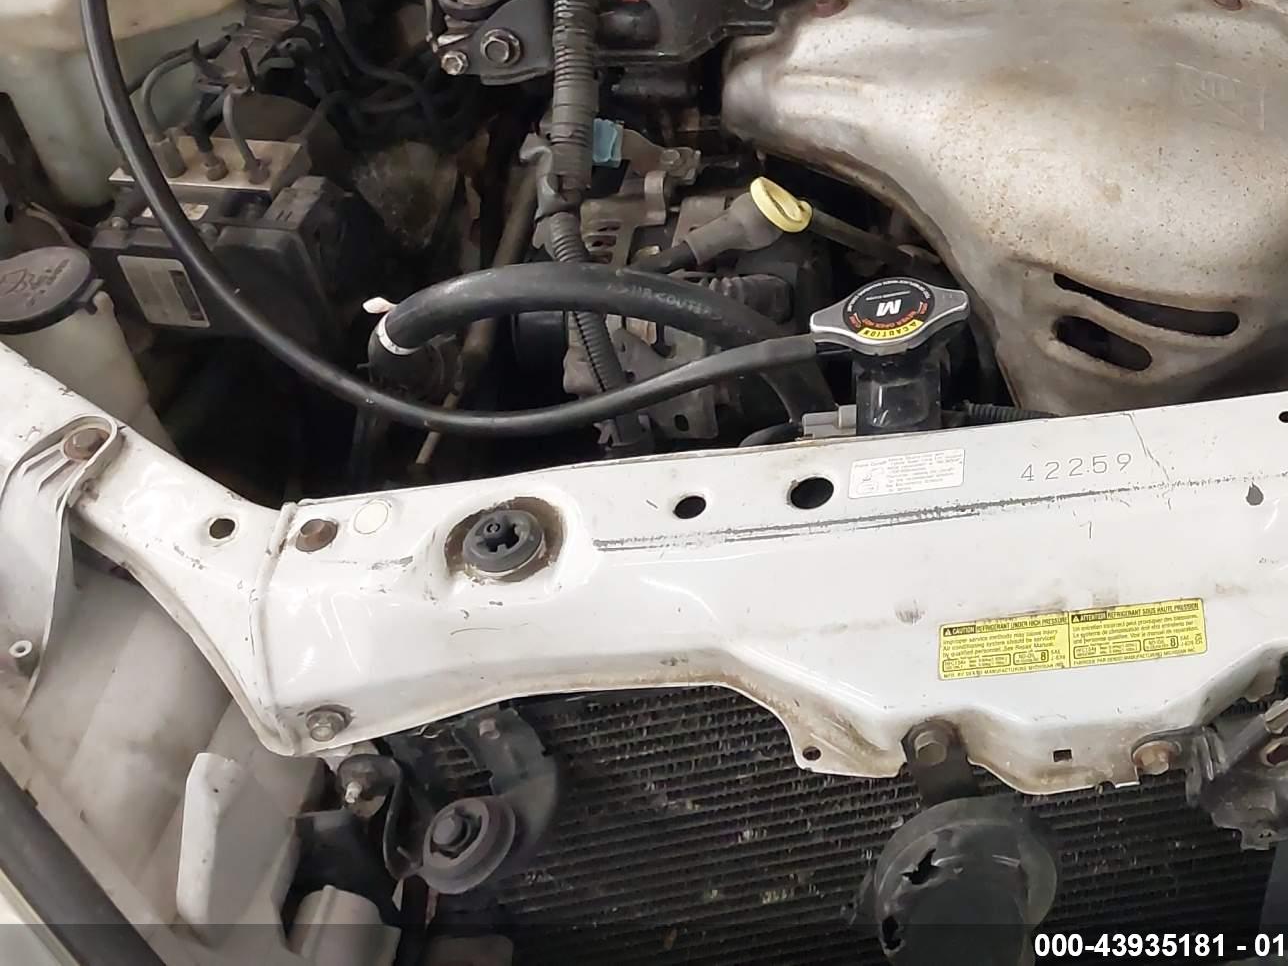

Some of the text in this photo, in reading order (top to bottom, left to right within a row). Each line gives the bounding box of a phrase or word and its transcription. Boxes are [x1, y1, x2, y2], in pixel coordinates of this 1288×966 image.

[863, 326, 910, 338] CAUTION
[1020, 453, 1132, 482] 42259
[952, 626, 976, 635] CAUTION
[1170, 638, 1176, 647] 8
[1040, 651, 1046, 661] 8
